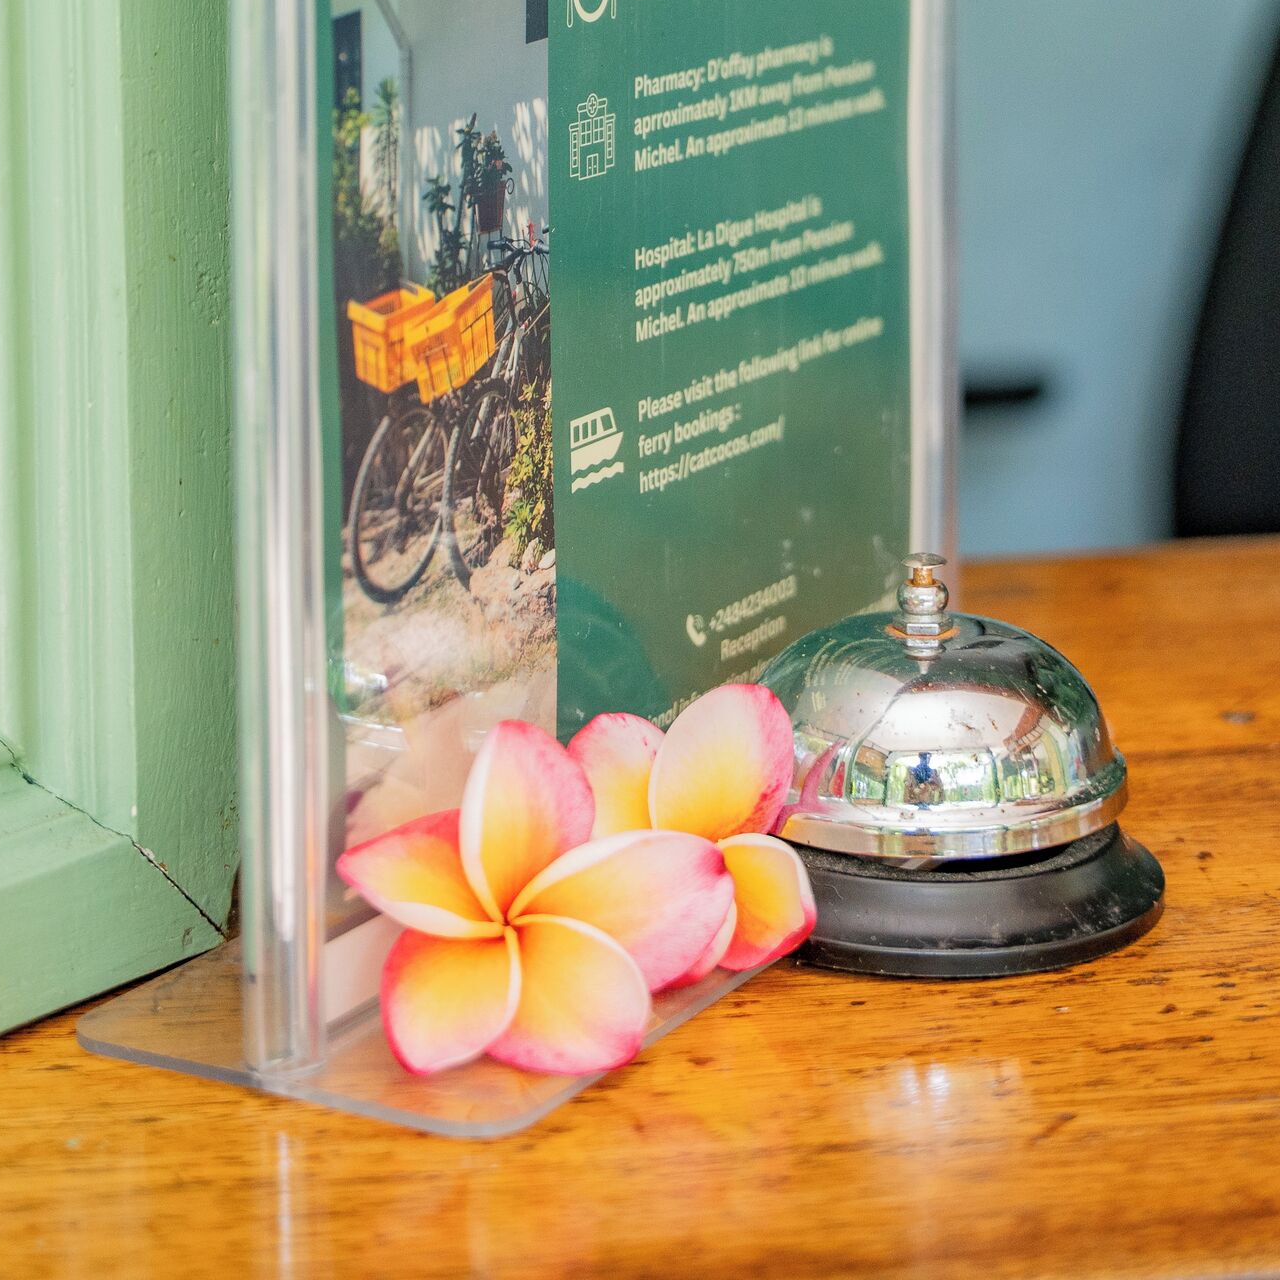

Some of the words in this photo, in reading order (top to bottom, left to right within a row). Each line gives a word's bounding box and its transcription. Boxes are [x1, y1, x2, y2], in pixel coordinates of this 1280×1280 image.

[634, 66, 704, 98] Pharmacy:
[755, 40, 818, 77] pharmacy
[759, 81, 791, 105] away
[634, 140, 683, 172] Michel.
[686, 135, 705, 158] An
[706, 115, 787, 156] approximate
[635, 231, 696, 270] Hospital:
[698, 228, 715, 251] La
[716, 219, 753, 247] Digue
[755, 200, 806, 232] Hospital
[635, 256, 732, 309] approximately
[732, 246, 769, 275] 750m
[770, 238, 802, 263] from
[636, 308, 684, 343] Michel.
[687, 301, 705, 325] An
[706, 275, 789, 320] approximate
[638, 394, 682, 422] Please
[684, 376, 714, 405] visit
[714, 368, 737, 394] the
[738, 347, 799, 384] following
[638, 428, 671, 458] ferry
[721, 615, 787, 661] Reception
